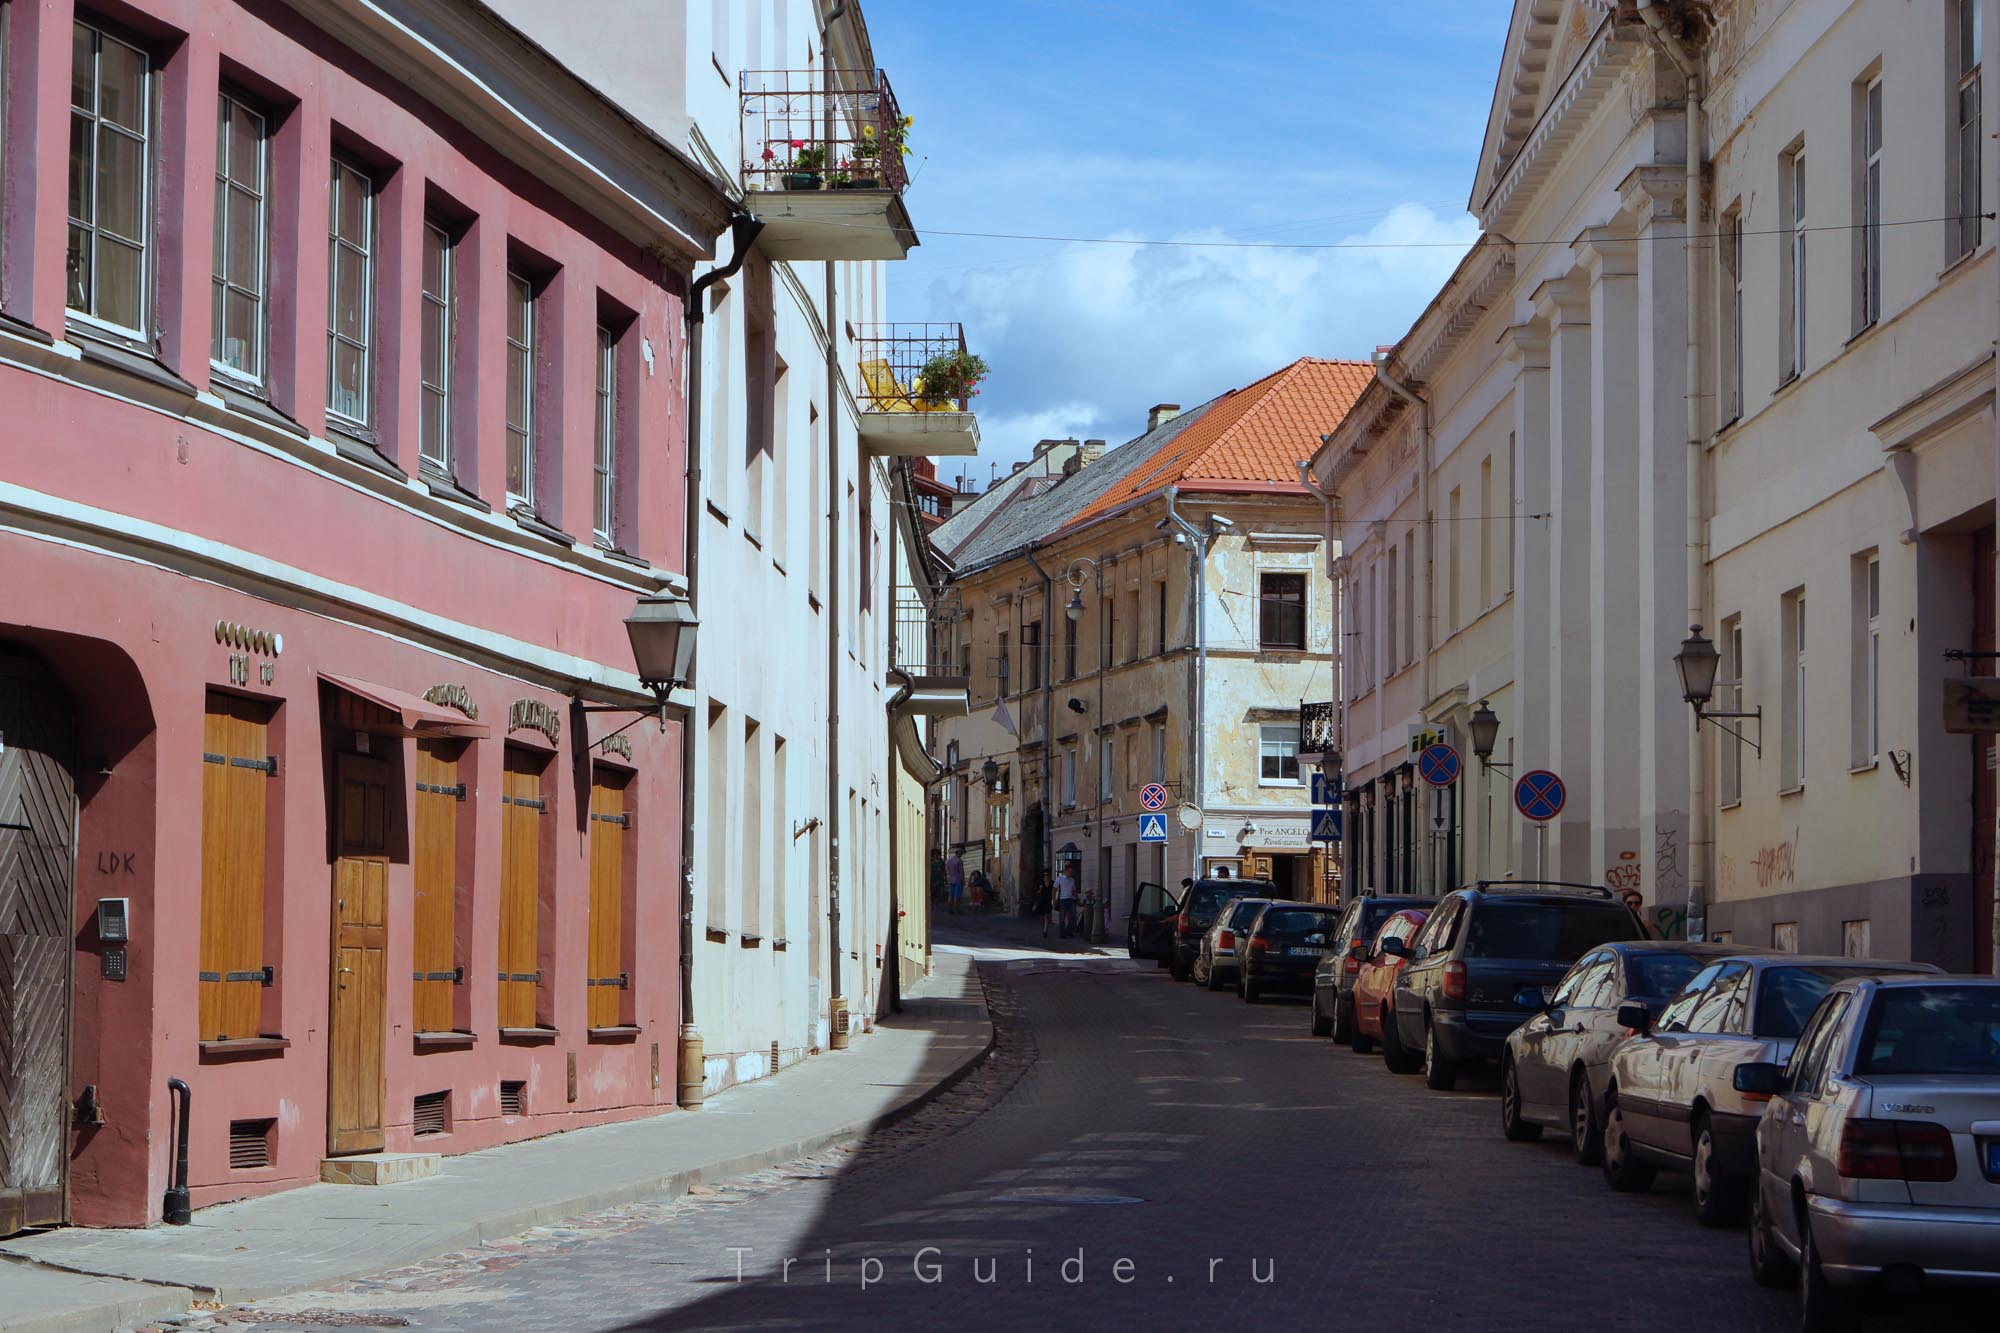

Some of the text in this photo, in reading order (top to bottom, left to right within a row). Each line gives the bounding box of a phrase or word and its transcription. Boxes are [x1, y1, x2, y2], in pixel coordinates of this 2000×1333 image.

[1412, 729, 1444, 752] iki
[1274, 827, 1310, 836] ANGELO
[98, 851, 136, 875] LDK
